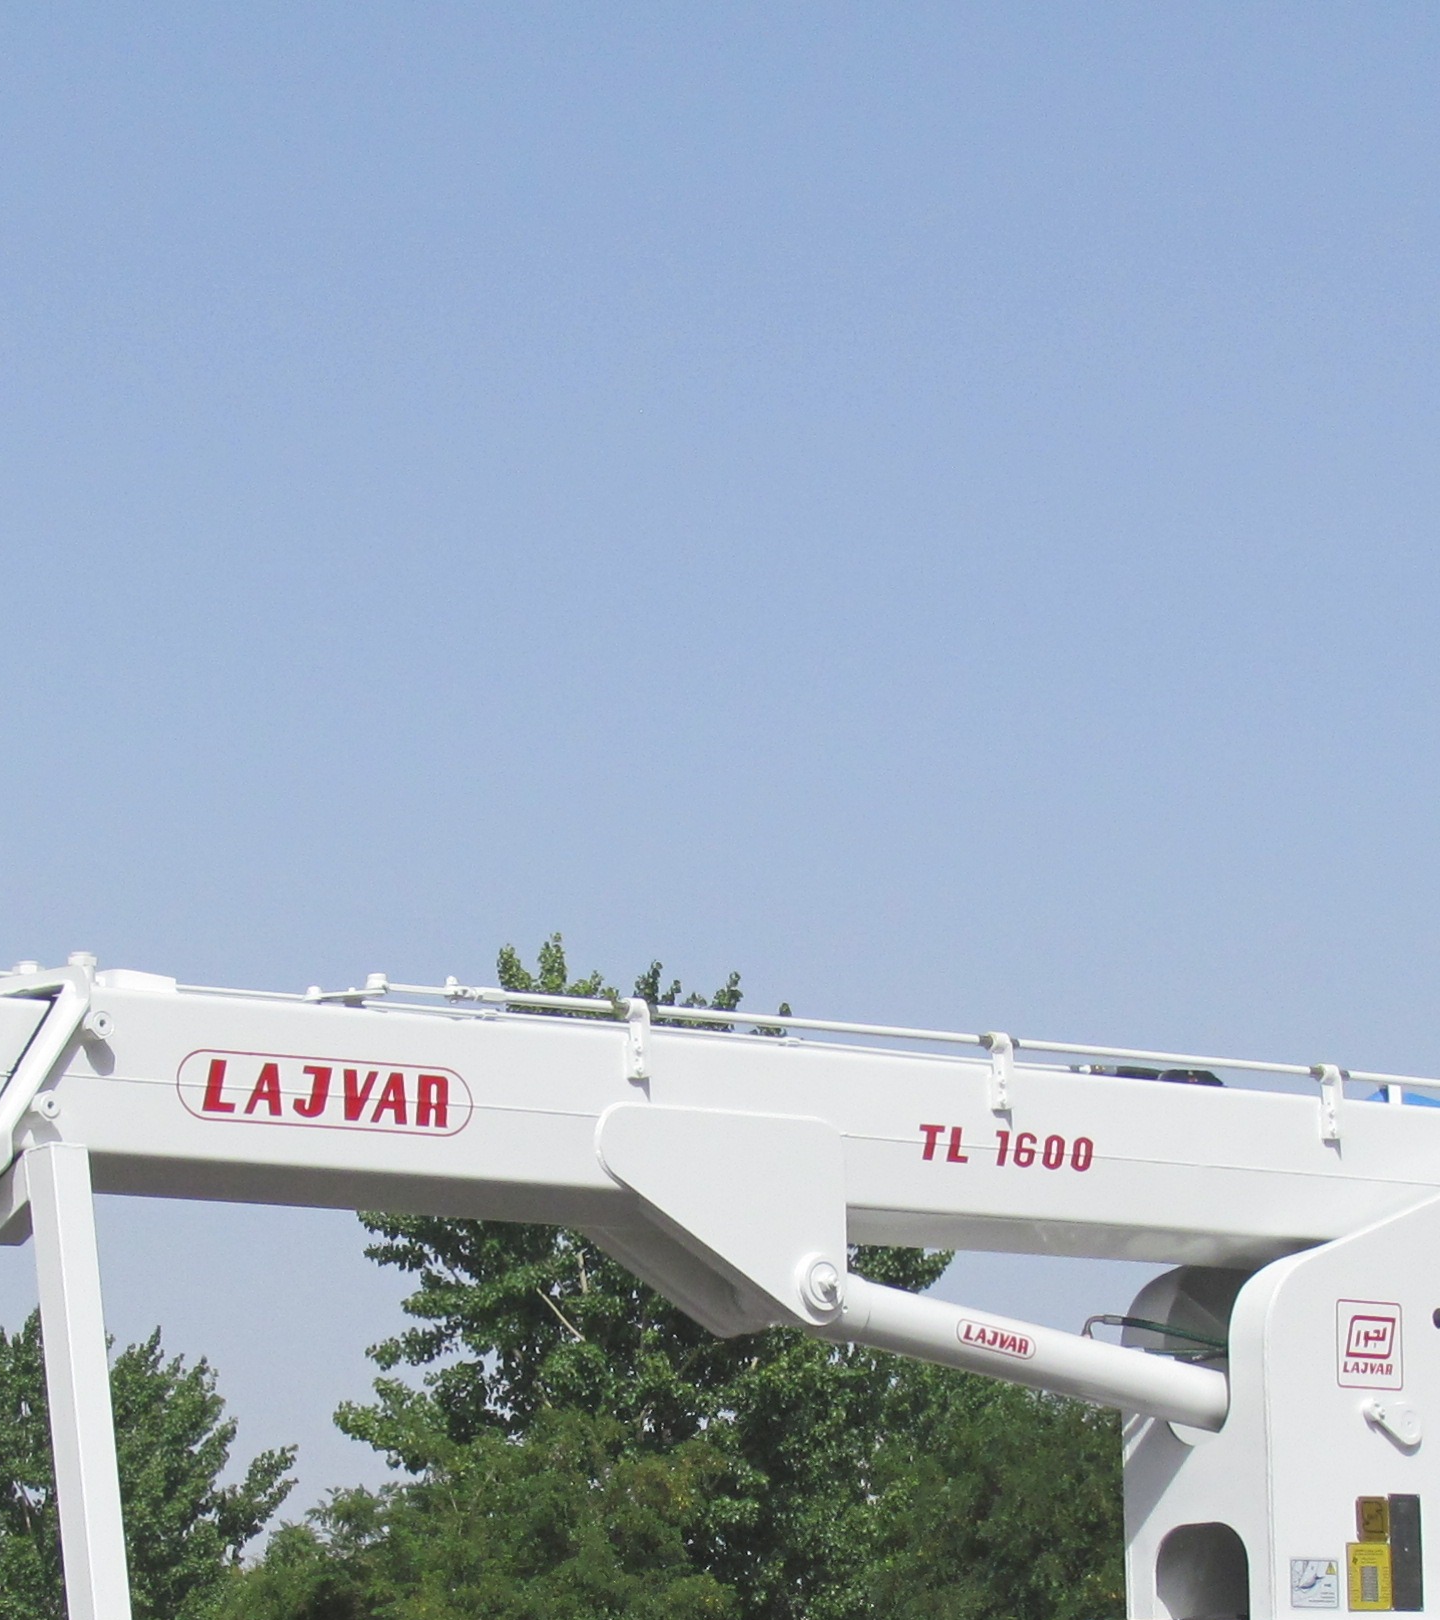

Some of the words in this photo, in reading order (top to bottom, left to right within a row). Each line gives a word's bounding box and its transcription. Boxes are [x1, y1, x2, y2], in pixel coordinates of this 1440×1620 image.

[202, 1058, 448, 1128] LAJVAR
[919, 1123, 969, 1164] TL
[996, 1129, 1093, 1172] 1600
[963, 1323, 1029, 1355] LAJVAR
[1343, 1360, 1393, 1376] LAJVAR
